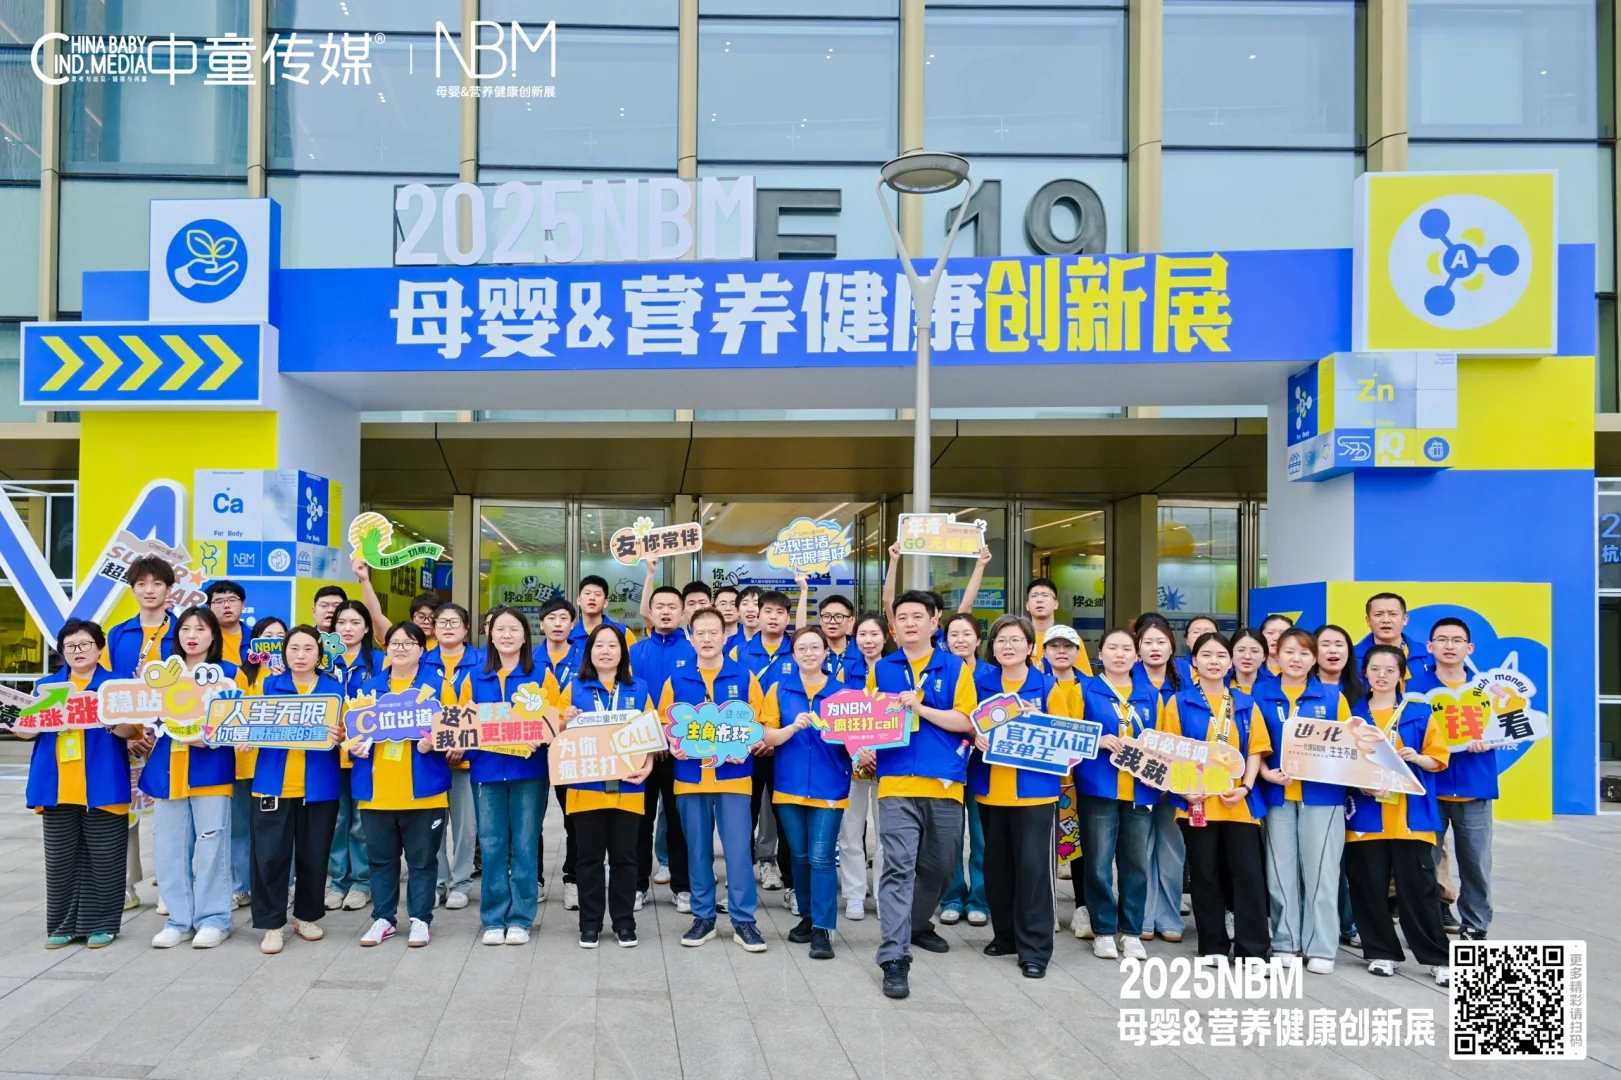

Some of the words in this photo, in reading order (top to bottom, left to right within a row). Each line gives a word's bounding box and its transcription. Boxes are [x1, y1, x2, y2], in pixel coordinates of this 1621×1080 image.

[395, 176, 755, 266] 2025NBM
[390, 252, 1233, 360] 母婴&营养健康创新展
[1357, 378, 1394, 401] Zn
[213, 493, 244, 514] Ca
[227, 530, 243, 538] Body
[774, 535, 829, 555] 发现生活
[904, 538, 925, 549] GO
[789, 546, 845, 568] 无限美好
[1602, 545, 1621, 562] 杭
[106, 546, 188, 584] SUR
[1473, 678, 1490, 697] Rich
[1495, 673, 1528, 694] money
[222, 701, 327, 725] 人生无限
[827, 701, 872, 717] 为NBM
[356, 708, 432, 734] C位出道
[687, 721, 750, 743] 主角光环
[834, 716, 899, 732] 疯狂打call
[216, 726, 328, 742] 你是最耀眼的星
[618, 726, 656, 749] CALL
[1006, 724, 1095, 754] 官方认证
[558, 737, 597, 758] 为你
[994, 739, 1056, 762] 签单王
[1143, 732, 1209, 763] 何必低调
[1329, 745, 1358, 760] 生生不息
[559, 755, 618, 780] 疯狂打
